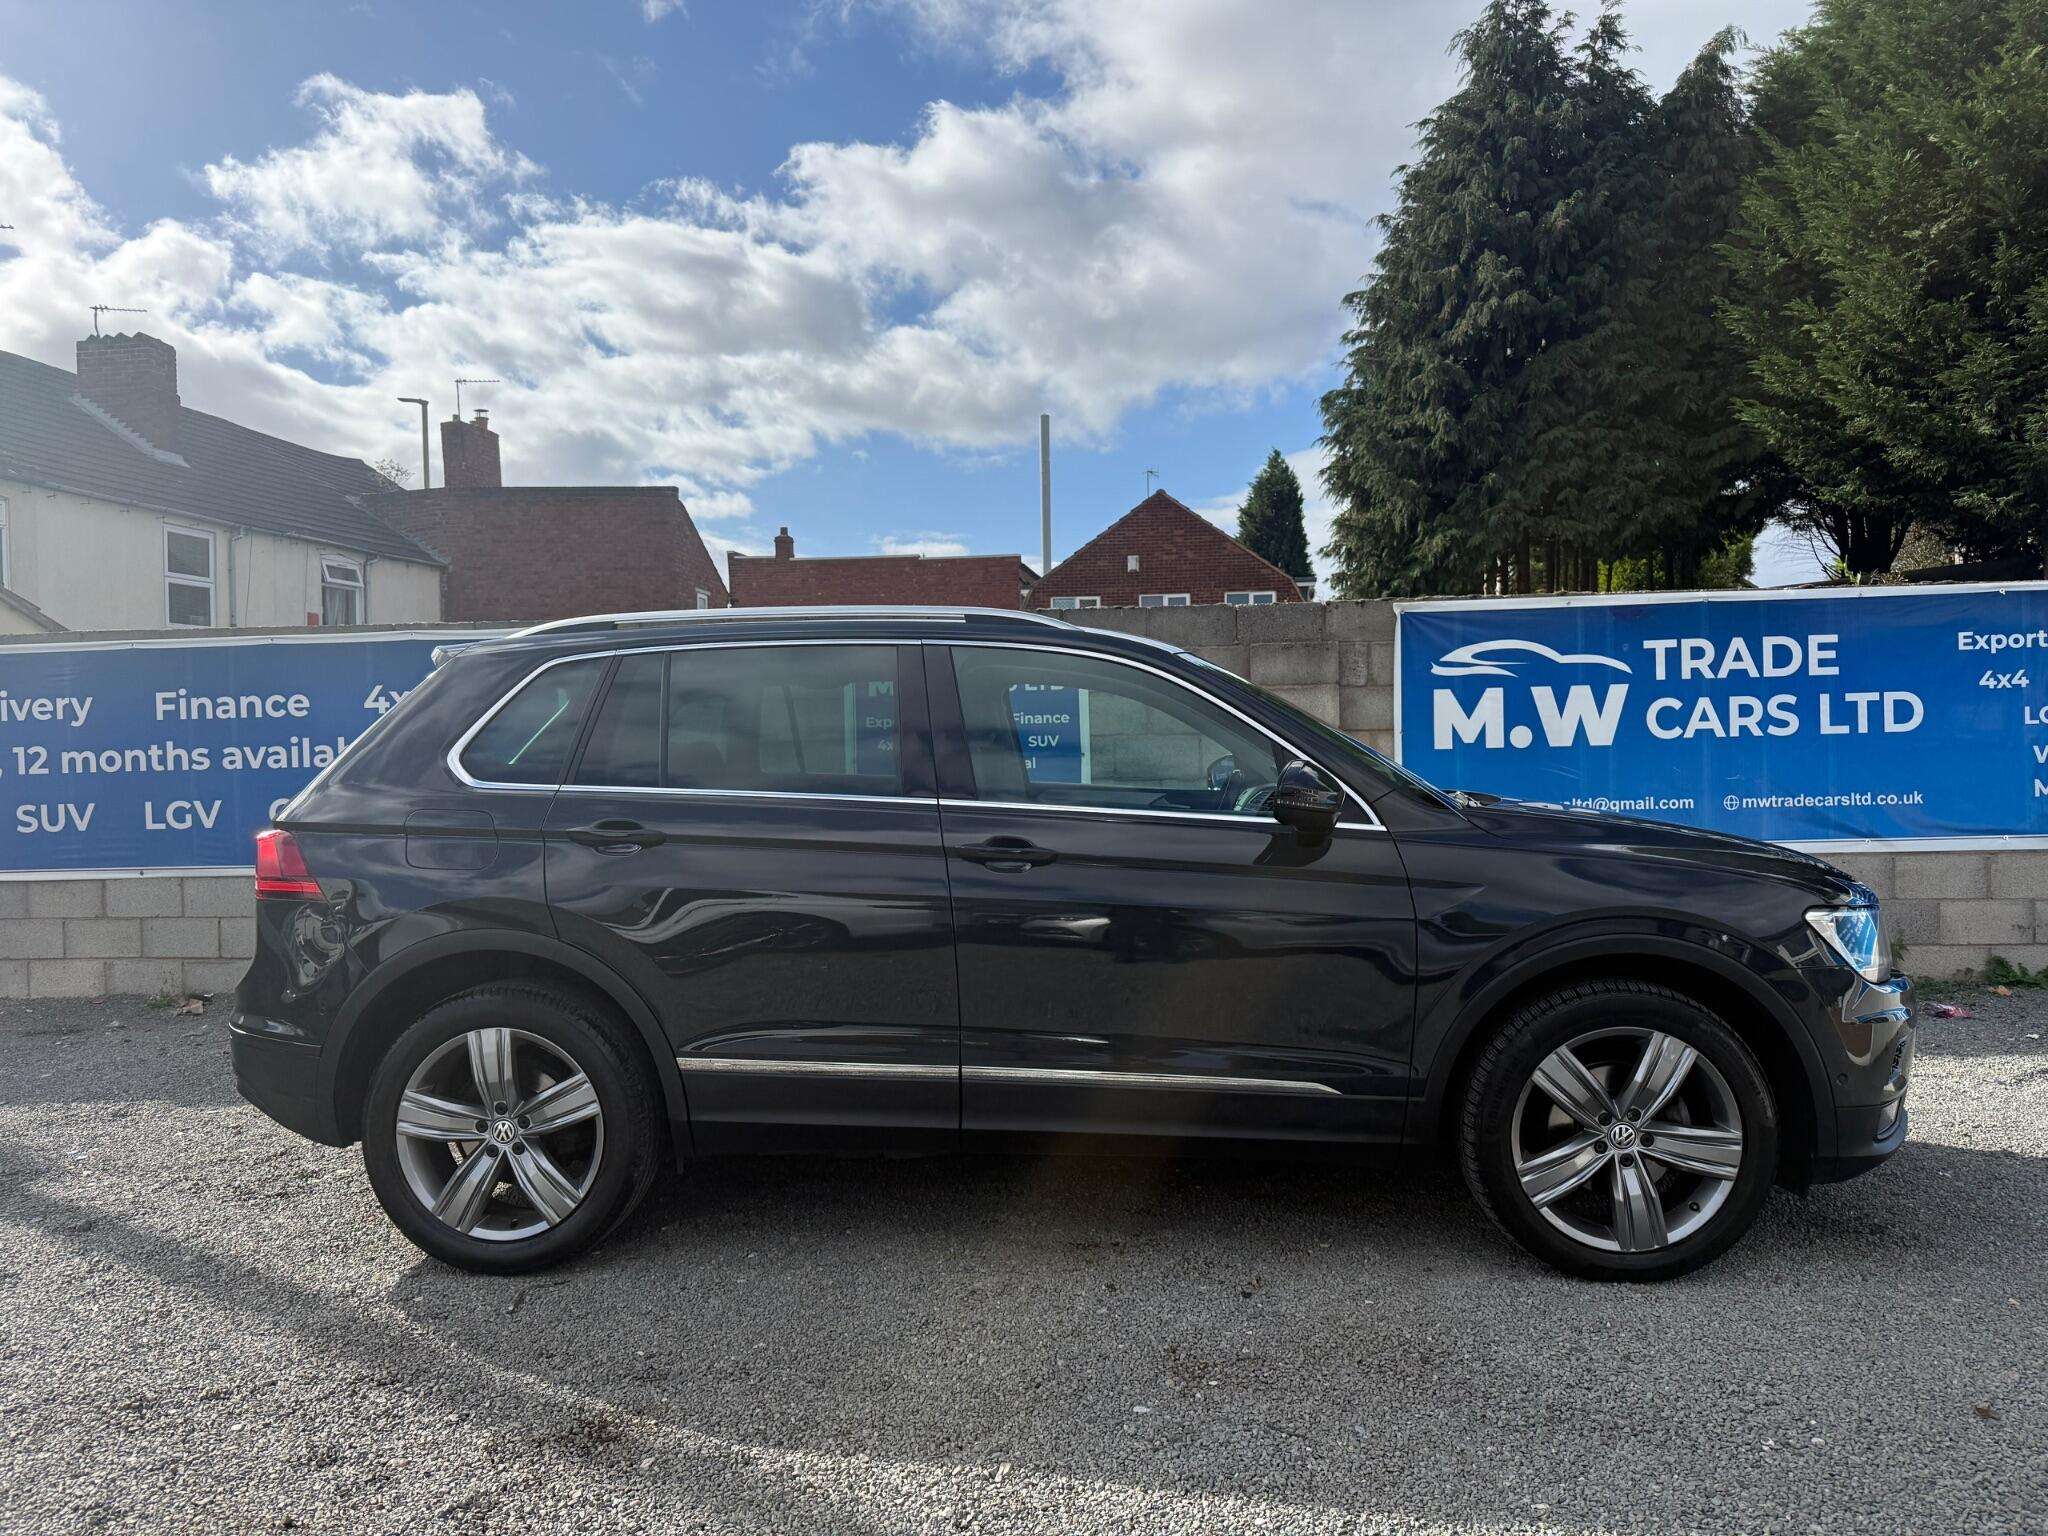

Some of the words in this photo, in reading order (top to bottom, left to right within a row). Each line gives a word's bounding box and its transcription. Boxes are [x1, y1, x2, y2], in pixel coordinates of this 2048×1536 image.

[1643, 634, 1839, 680] TRADE
[1957, 630, 2048, 654] Export
[1979, 669, 2030, 689] 4x4
[0, 690, 93, 727] ivery
[155, 689, 310, 721] Finance
[1433, 684, 1629, 750] M.W
[1646, 694, 1800, 740] CARS
[1820, 691, 1925, 736] LTD
[12, 746, 50, 775] 12
[62, 740, 211, 774] months
[1028, 735, 1060, 747] SUV
[16, 802, 95, 833] SUV
[145, 800, 222, 830] LGV
[1742, 791, 1924, 808] mwtradecarsltd.co.uk
